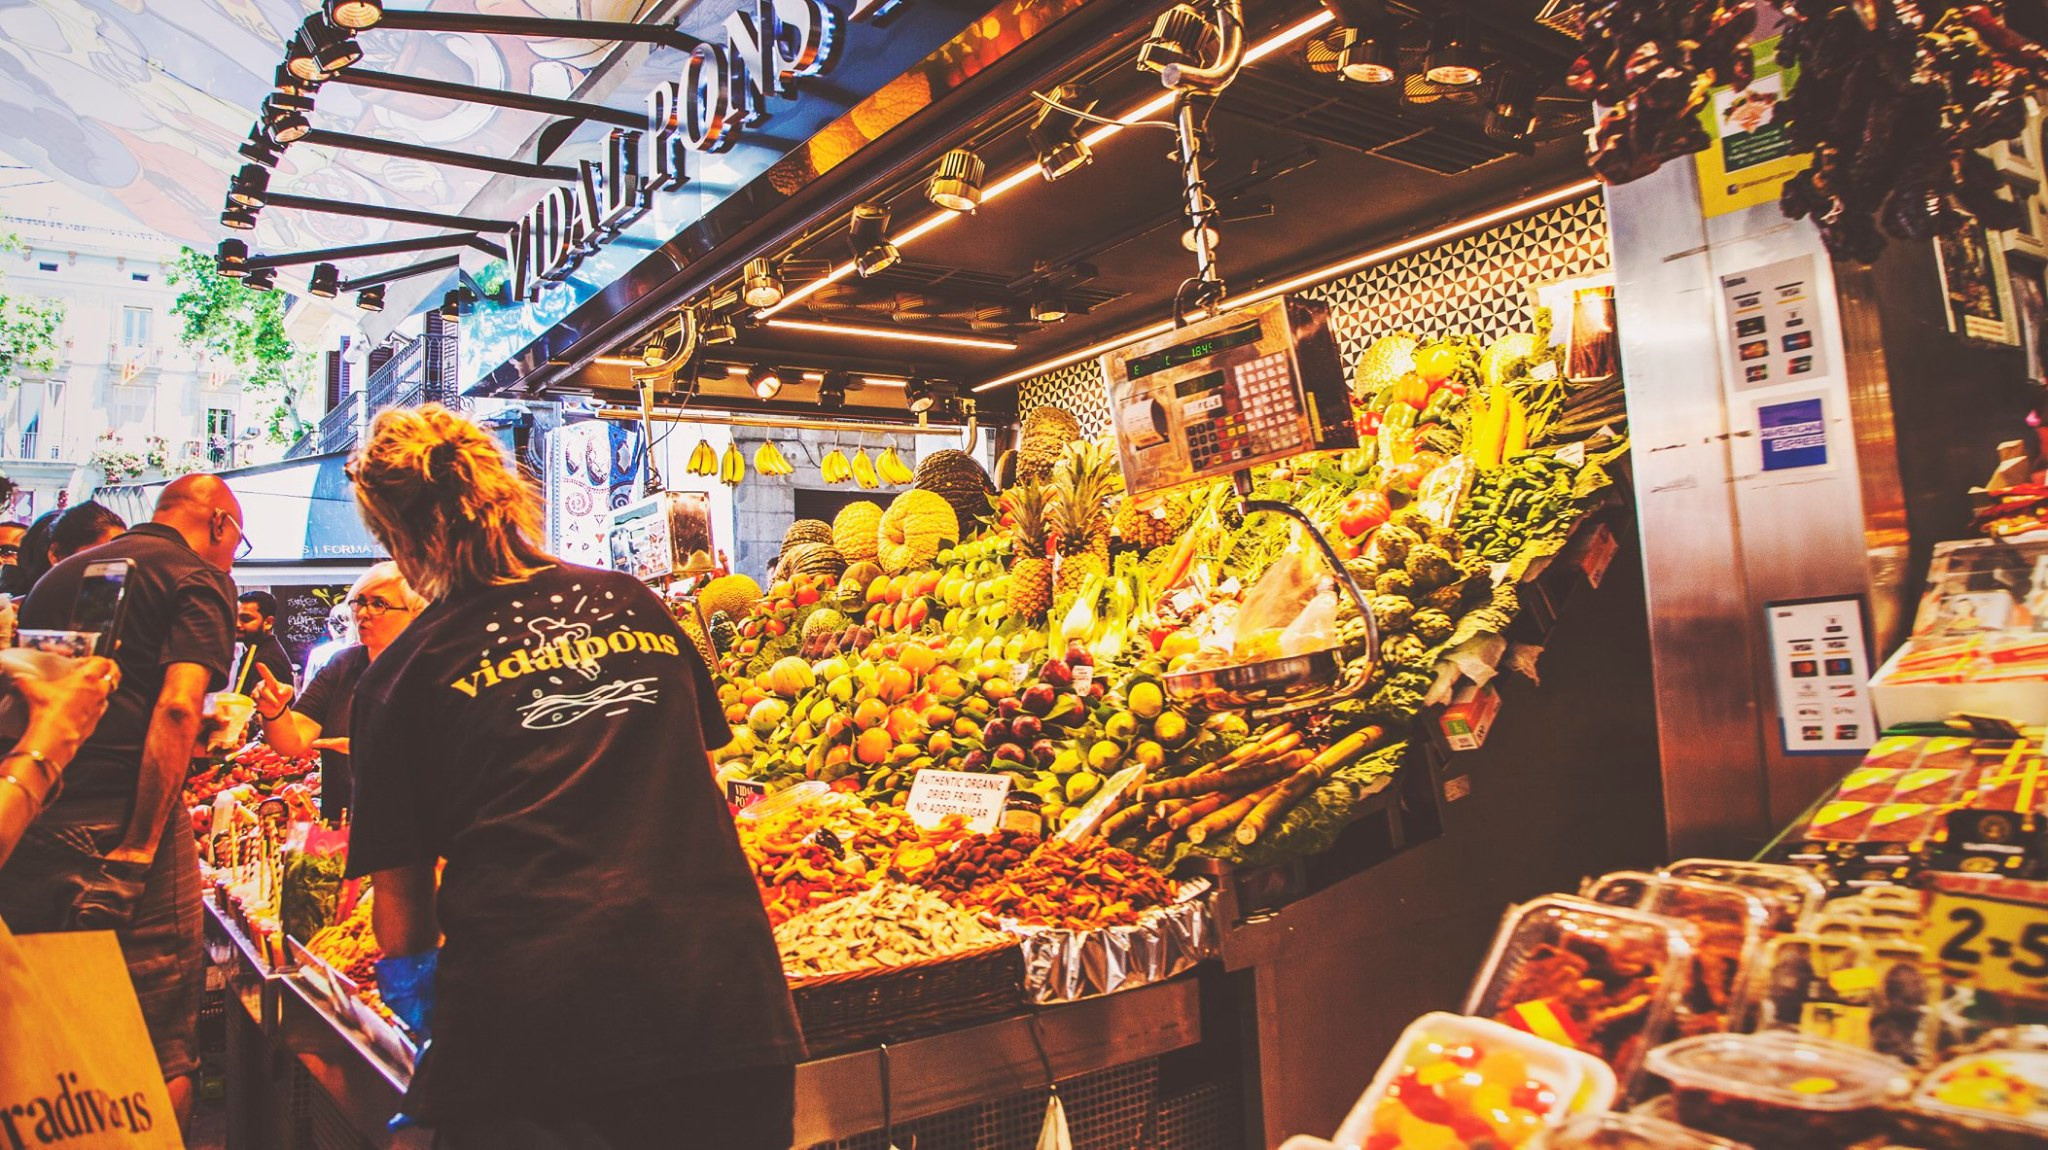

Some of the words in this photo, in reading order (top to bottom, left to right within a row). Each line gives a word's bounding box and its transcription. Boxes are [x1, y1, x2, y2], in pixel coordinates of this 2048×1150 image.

[505, 128, 638, 302] VIDAL
[1761, 420, 1824, 440] AMERICAN
[1772, 434, 1827, 452] EXPRESS
[451, 631, 680, 698] vidalpons
[920, 775, 963, 788] AUTHENTIC
[965, 778, 1004, 791] ORGANIC
[927, 789, 951, 800] DRIED
[915, 802, 928, 812] NO
[930, 803, 957, 815] ADDED
[960, 806, 988, 818] SUGAR
